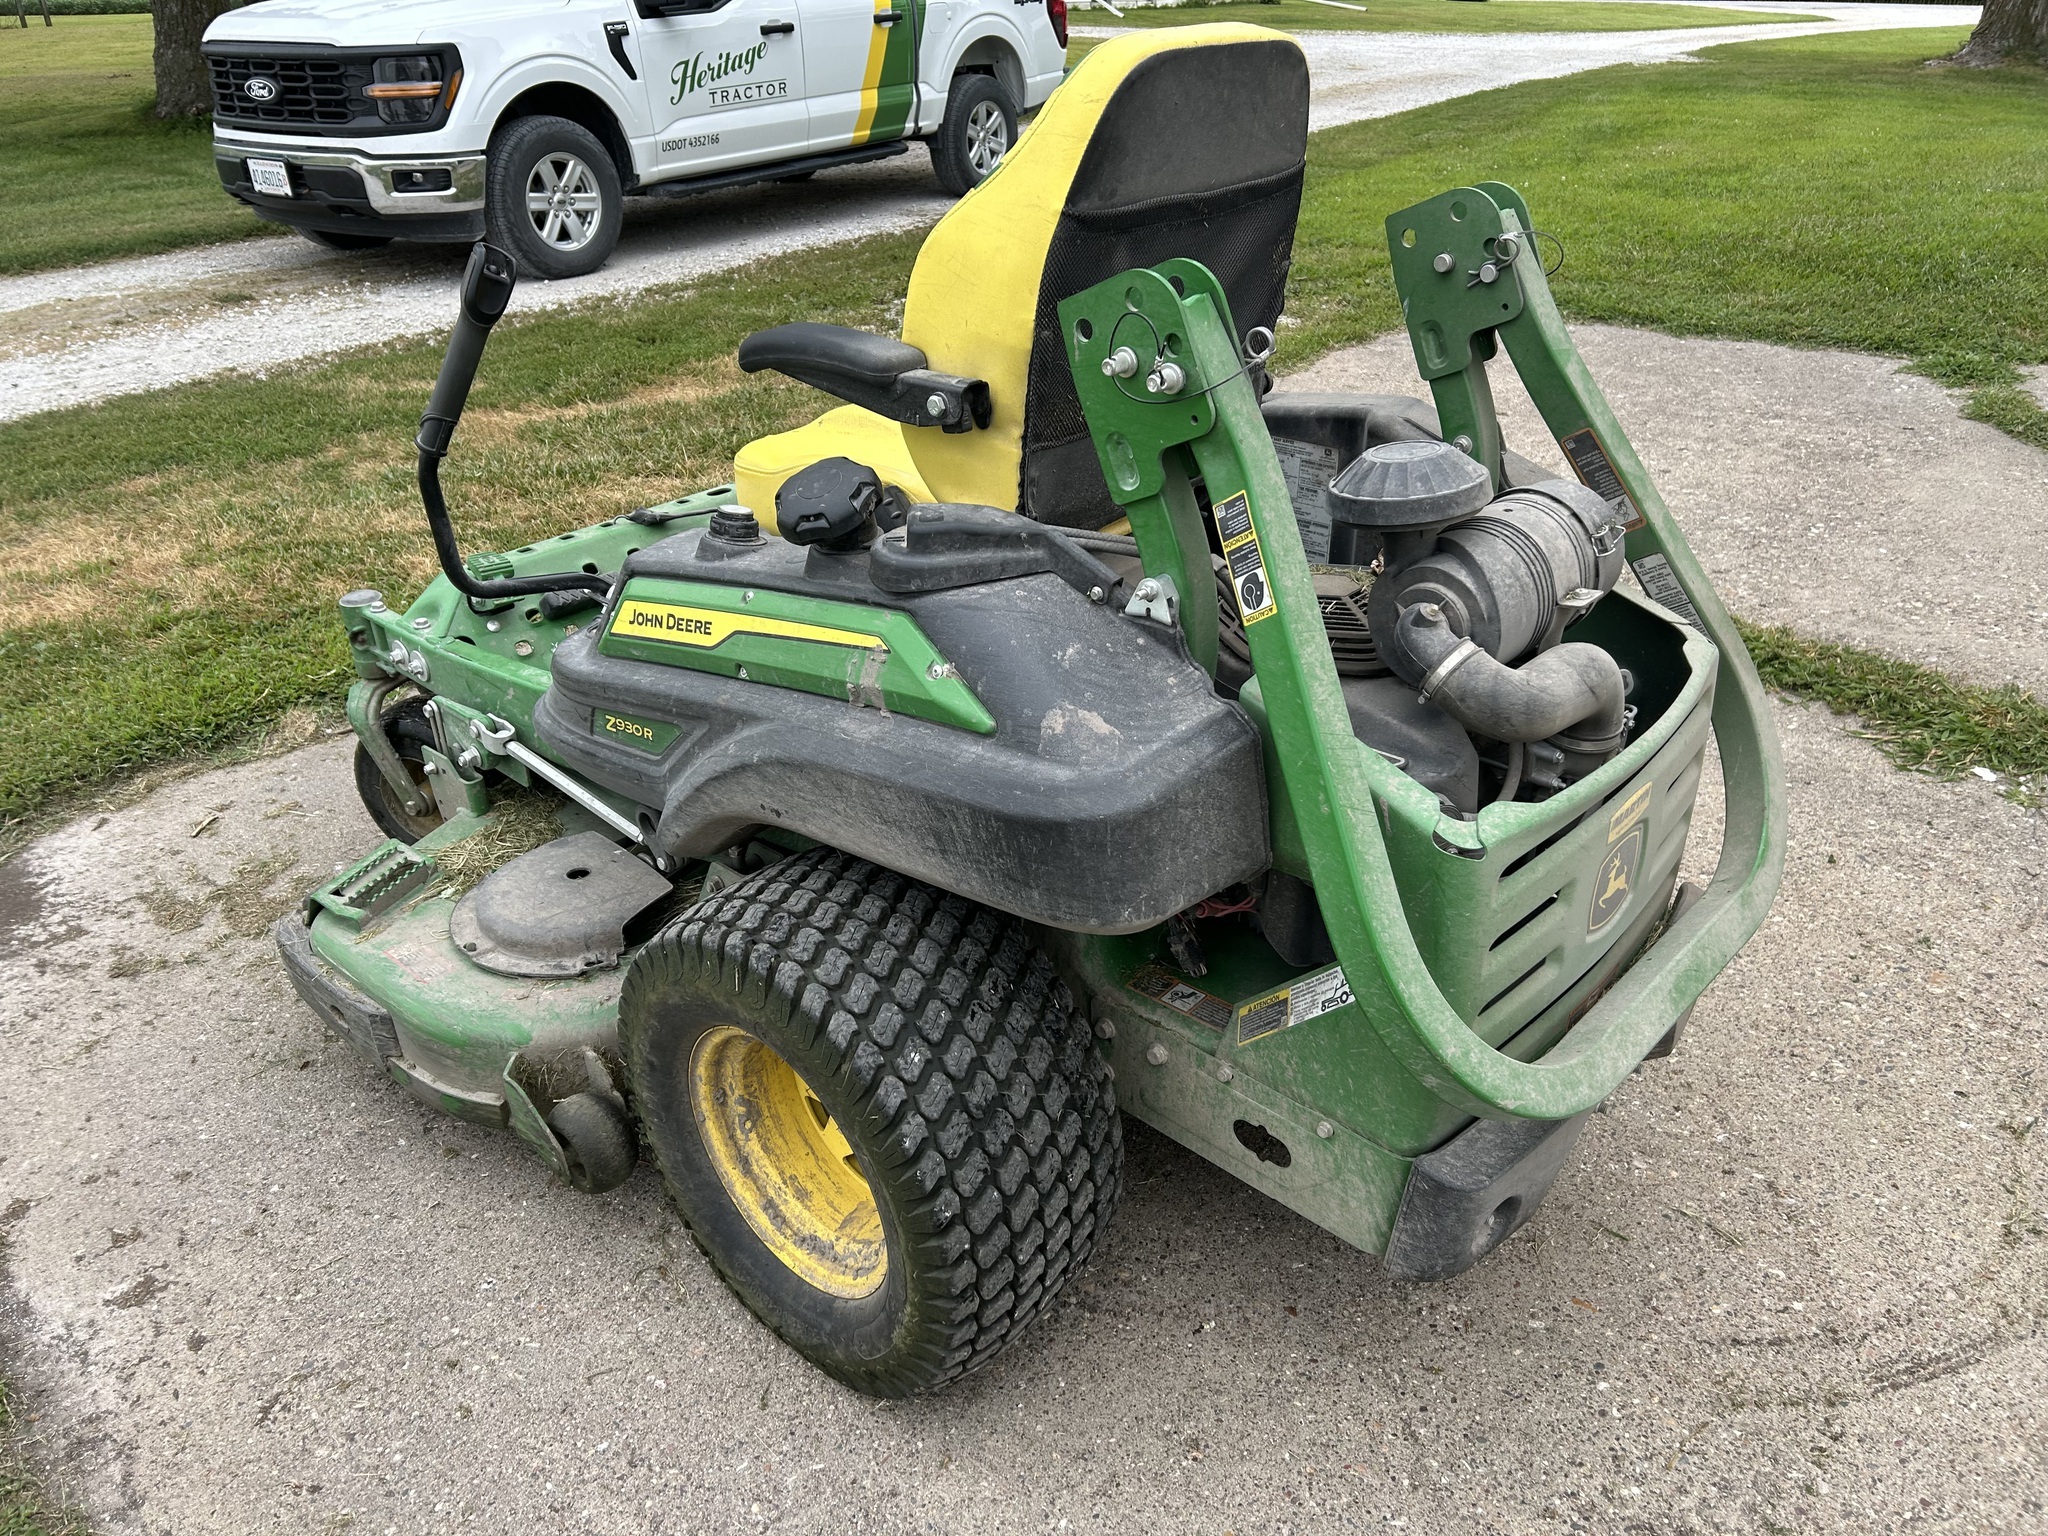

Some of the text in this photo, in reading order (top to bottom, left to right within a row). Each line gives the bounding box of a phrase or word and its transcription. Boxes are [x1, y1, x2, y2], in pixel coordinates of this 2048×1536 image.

[670, 41, 768, 105] Heritage
[248, 81, 271, 98] Ford
[709, 82, 787, 104] TRACTOR
[661, 133, 720, 152] USDOT 4352166
[629, 609, 712, 636] JOHN DEERE
[1245, 609, 1269, 624] CAUTION
[605, 714, 653, 741] Z930R
